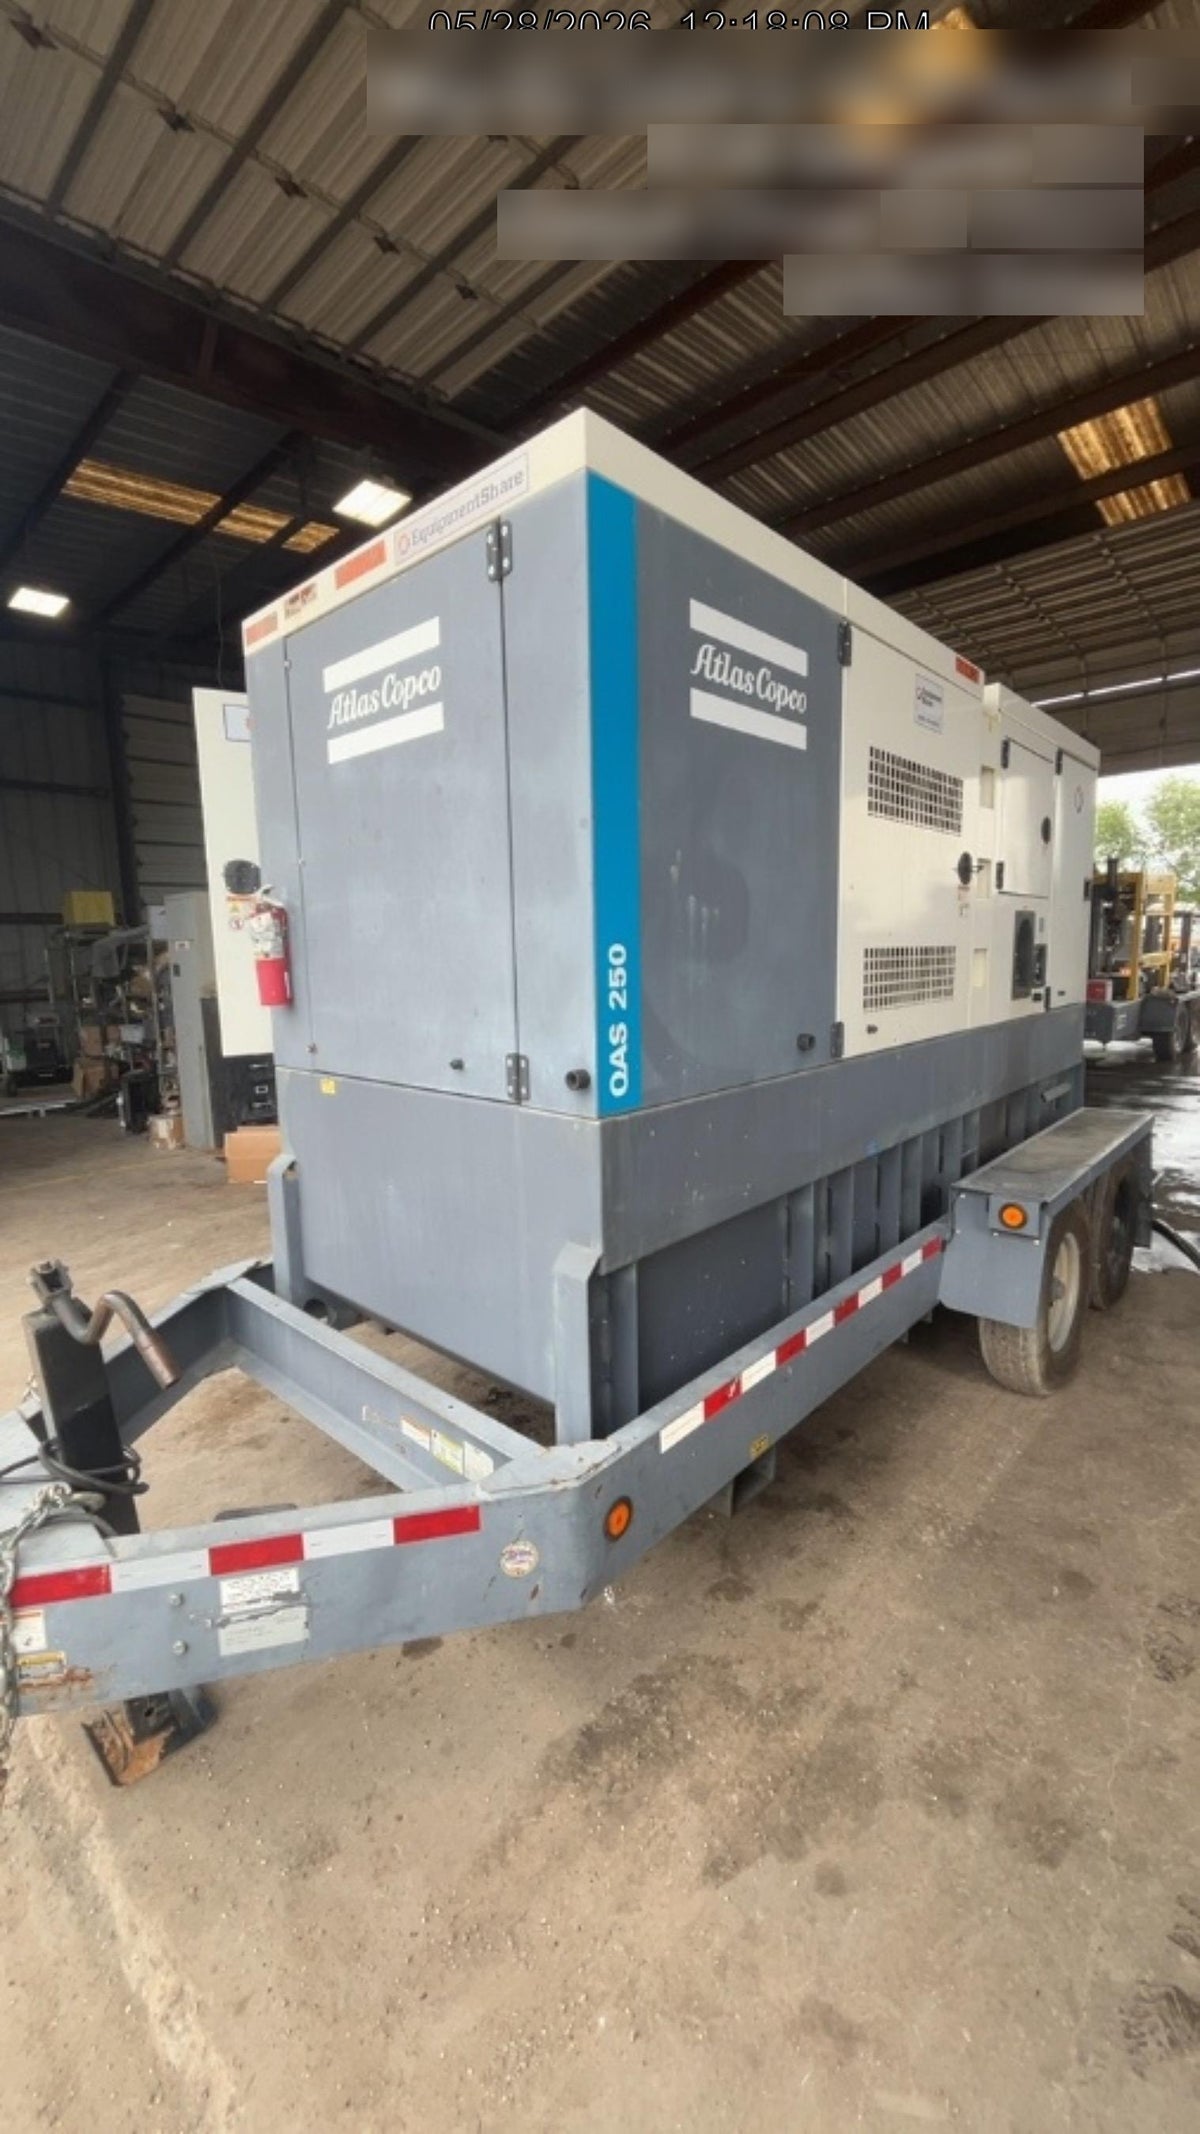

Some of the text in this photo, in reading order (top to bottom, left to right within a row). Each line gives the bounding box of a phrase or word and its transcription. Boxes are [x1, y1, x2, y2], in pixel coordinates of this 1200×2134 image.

[411, 470, 524, 547] EquipmentShare
[327, 665, 441, 730] Atlas Copco
[690, 644, 807, 714] Atlas Copco
[608, 943, 629, 1097] QAS 250
